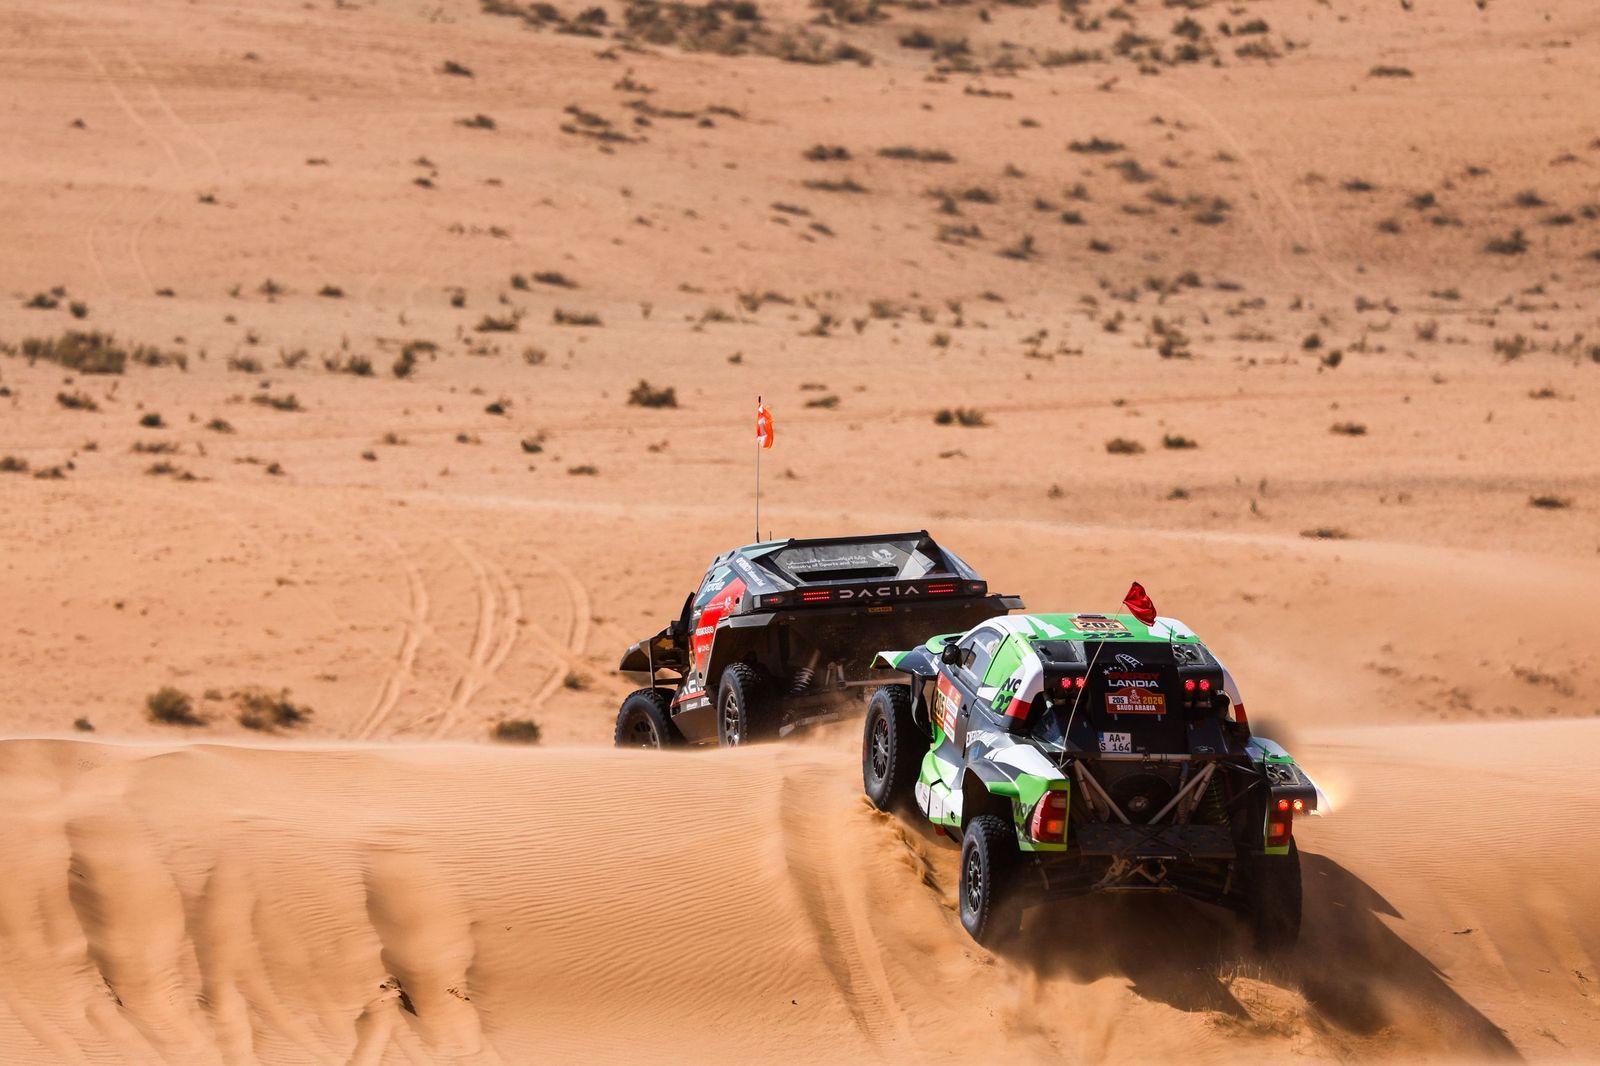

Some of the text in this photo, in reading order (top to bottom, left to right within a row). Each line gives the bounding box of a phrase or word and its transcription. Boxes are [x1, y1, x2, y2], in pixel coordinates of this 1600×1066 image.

[839, 585, 919, 599] DACIA
[1108, 679, 1159, 688] LANDIA
[1112, 696, 1125, 704] 205
[1109, 734, 1121, 742] AA
